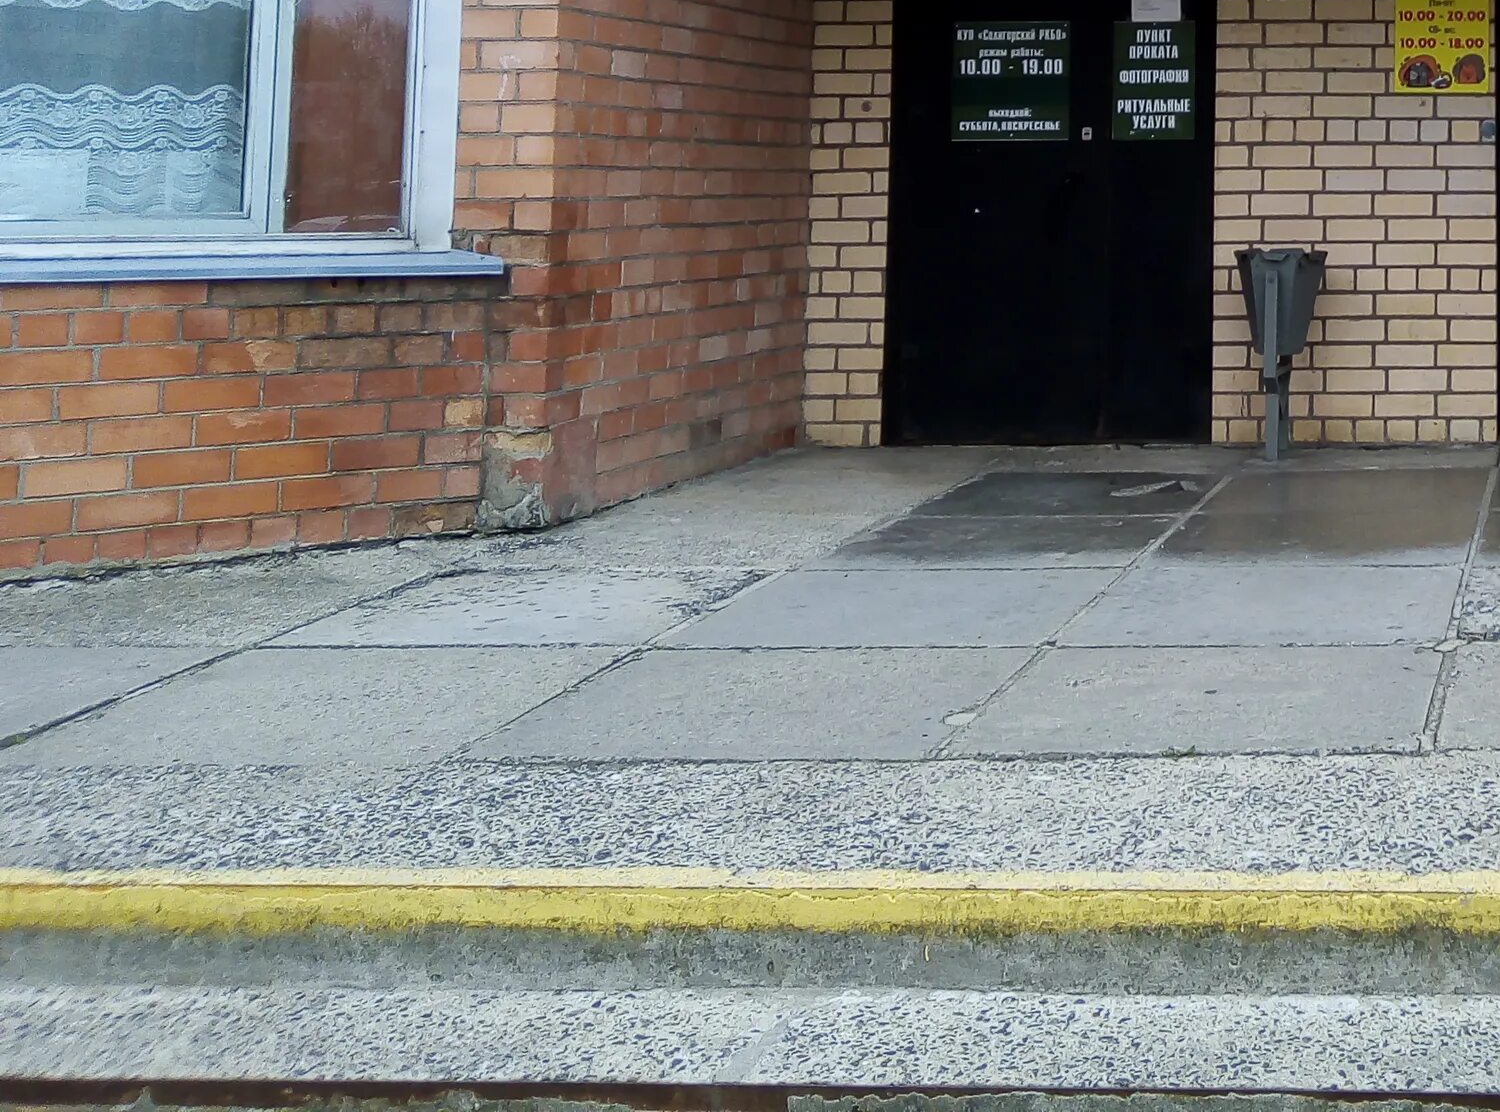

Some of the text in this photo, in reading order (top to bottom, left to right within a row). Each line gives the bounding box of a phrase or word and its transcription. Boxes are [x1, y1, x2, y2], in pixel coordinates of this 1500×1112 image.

[1398, 10, 1436, 22] 10.00
[1447, 10, 1486, 22] 20.00
[1136, 28, 1172, 44] ПУНКТ
[1399, 37, 1437, 49] 10.00
[1129, 45, 1179, 60] ПРОКАТА
[959, 58, 1001, 75] 10.00
[1022, 58, 1063, 75] 19.00
[1119, 69, 1189, 84] ФОТОГРАФИЯ
[1117, 98, 1191, 114] РИТУАЛЬНЫЕ
[1132, 114, 1176, 130] УСЛУГИ
